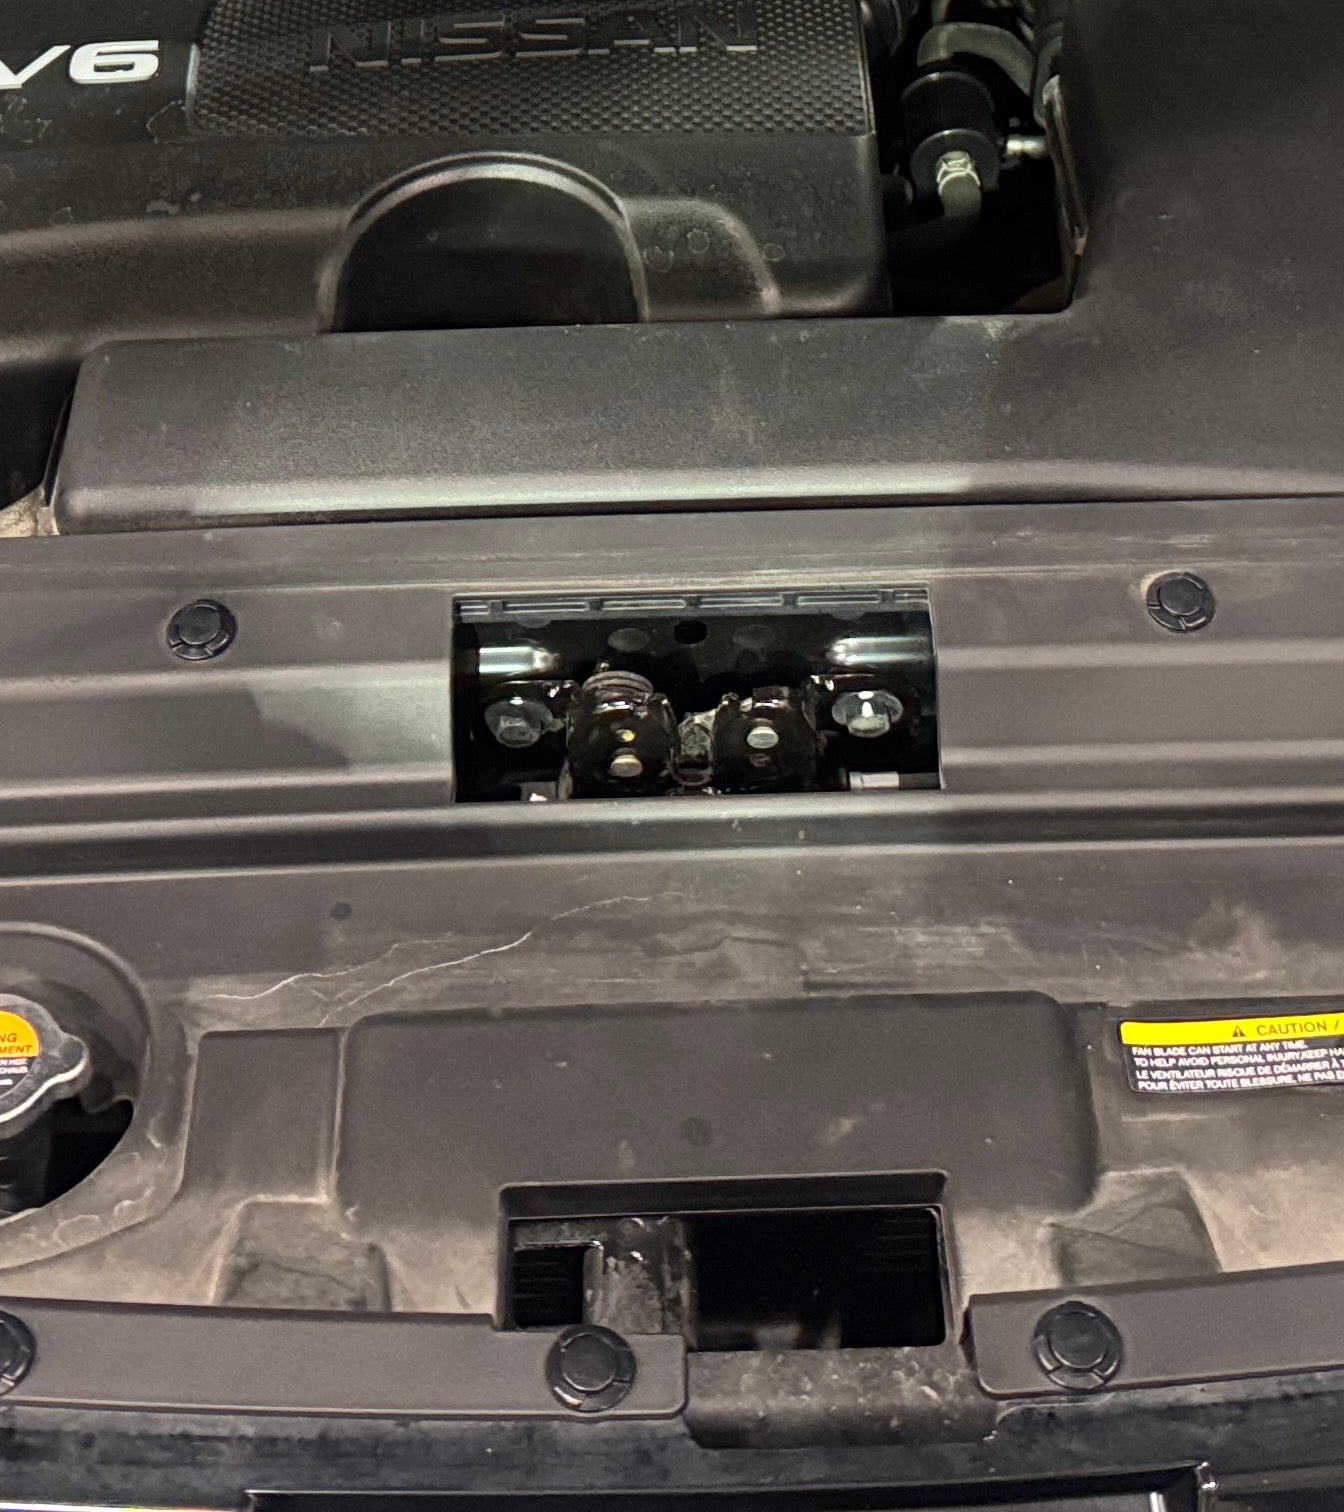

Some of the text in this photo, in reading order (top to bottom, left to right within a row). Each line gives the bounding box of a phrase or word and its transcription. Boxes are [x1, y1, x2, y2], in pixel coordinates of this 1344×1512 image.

[309, 3, 757, 72] NISSAN
[1256, 1020, 1327, 1036] CAUTION
[1132, 1046, 1152, 1056] FAN
[1154, 1046, 1186, 1056] BLADE
[1188, 1045, 1211, 1055] CAN
[1213, 1044, 1242, 1054] START
[1246, 1043, 1257, 1052] AT
[1260, 1041, 1280, 1051] ANY
[1134, 1058, 1148, 1067] TO
[1150, 1058, 1176, 1067] HELP
[1178, 1056, 1209, 1067] AVOID
[1211, 1055, 1265, 1065] PERSONAL
[1136, 1070, 1148, 1079] LE
[1150, 1068, 1216, 1079] VENTILATEUR
[1218, 1067, 1255, 1077] RISQUE
[1257, 1065, 1272, 1075] DE
[1274, 1060, 1330, 1073] DÉMARRER
[1331, 1057, 1340, 1069] À
[1138, 1081, 1168, 1090] POUR
[1169, 1079, 1204, 1090] ÉVITER
[1206, 1078, 1238, 1088] TOUTE
[1298, 1073, 1312, 1082] NE
[1314, 1071, 1335, 1080] PAS
